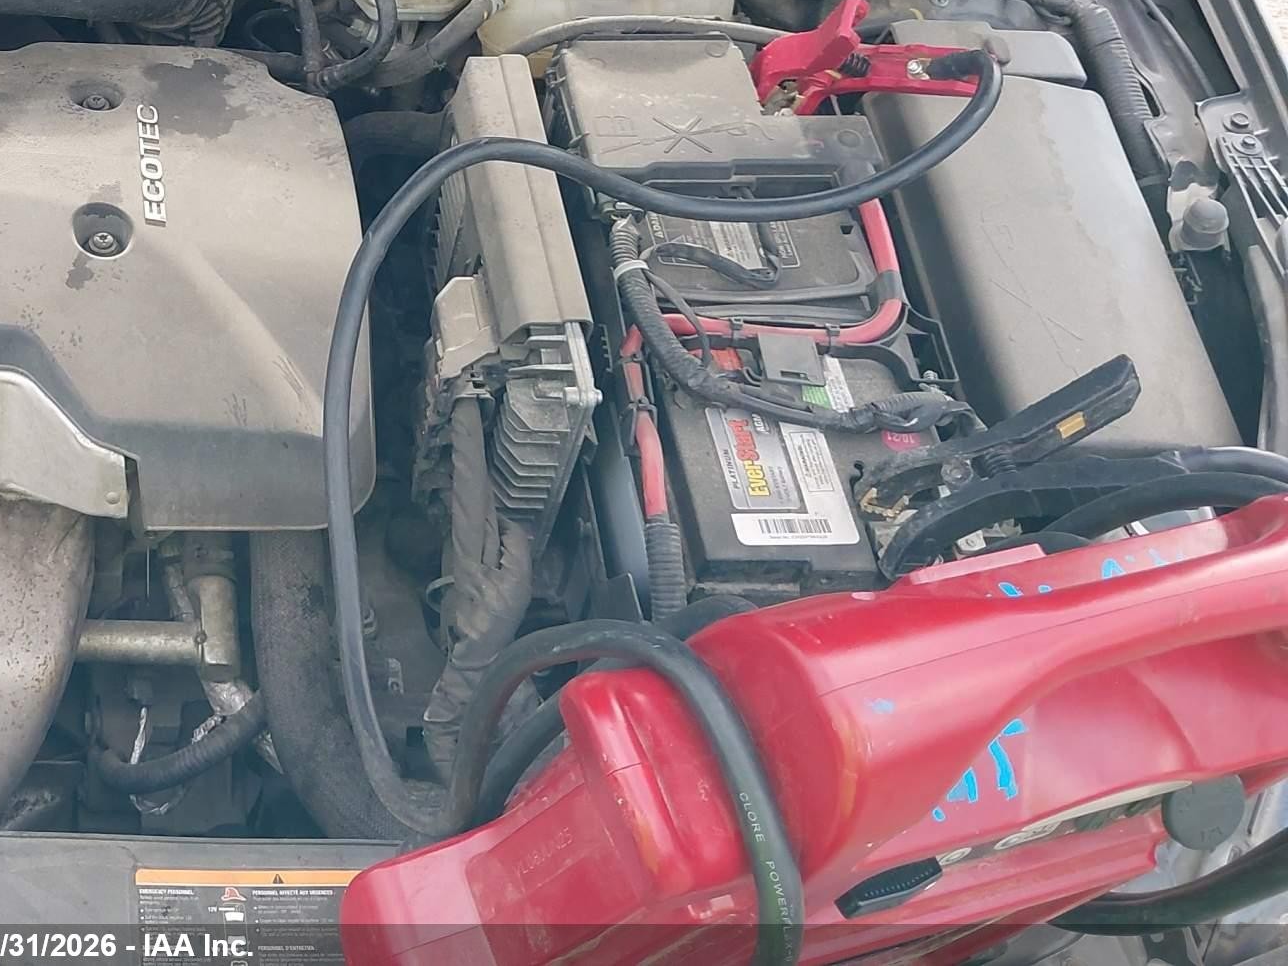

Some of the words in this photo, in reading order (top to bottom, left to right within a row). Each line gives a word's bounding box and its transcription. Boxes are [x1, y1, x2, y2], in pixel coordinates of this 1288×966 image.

[136, 104, 167, 223] ECOTEC
[722, 448, 740, 490] PLATINUM
[727, 418, 770, 498] EverStart
[739, 792, 766, 843] CLORE
